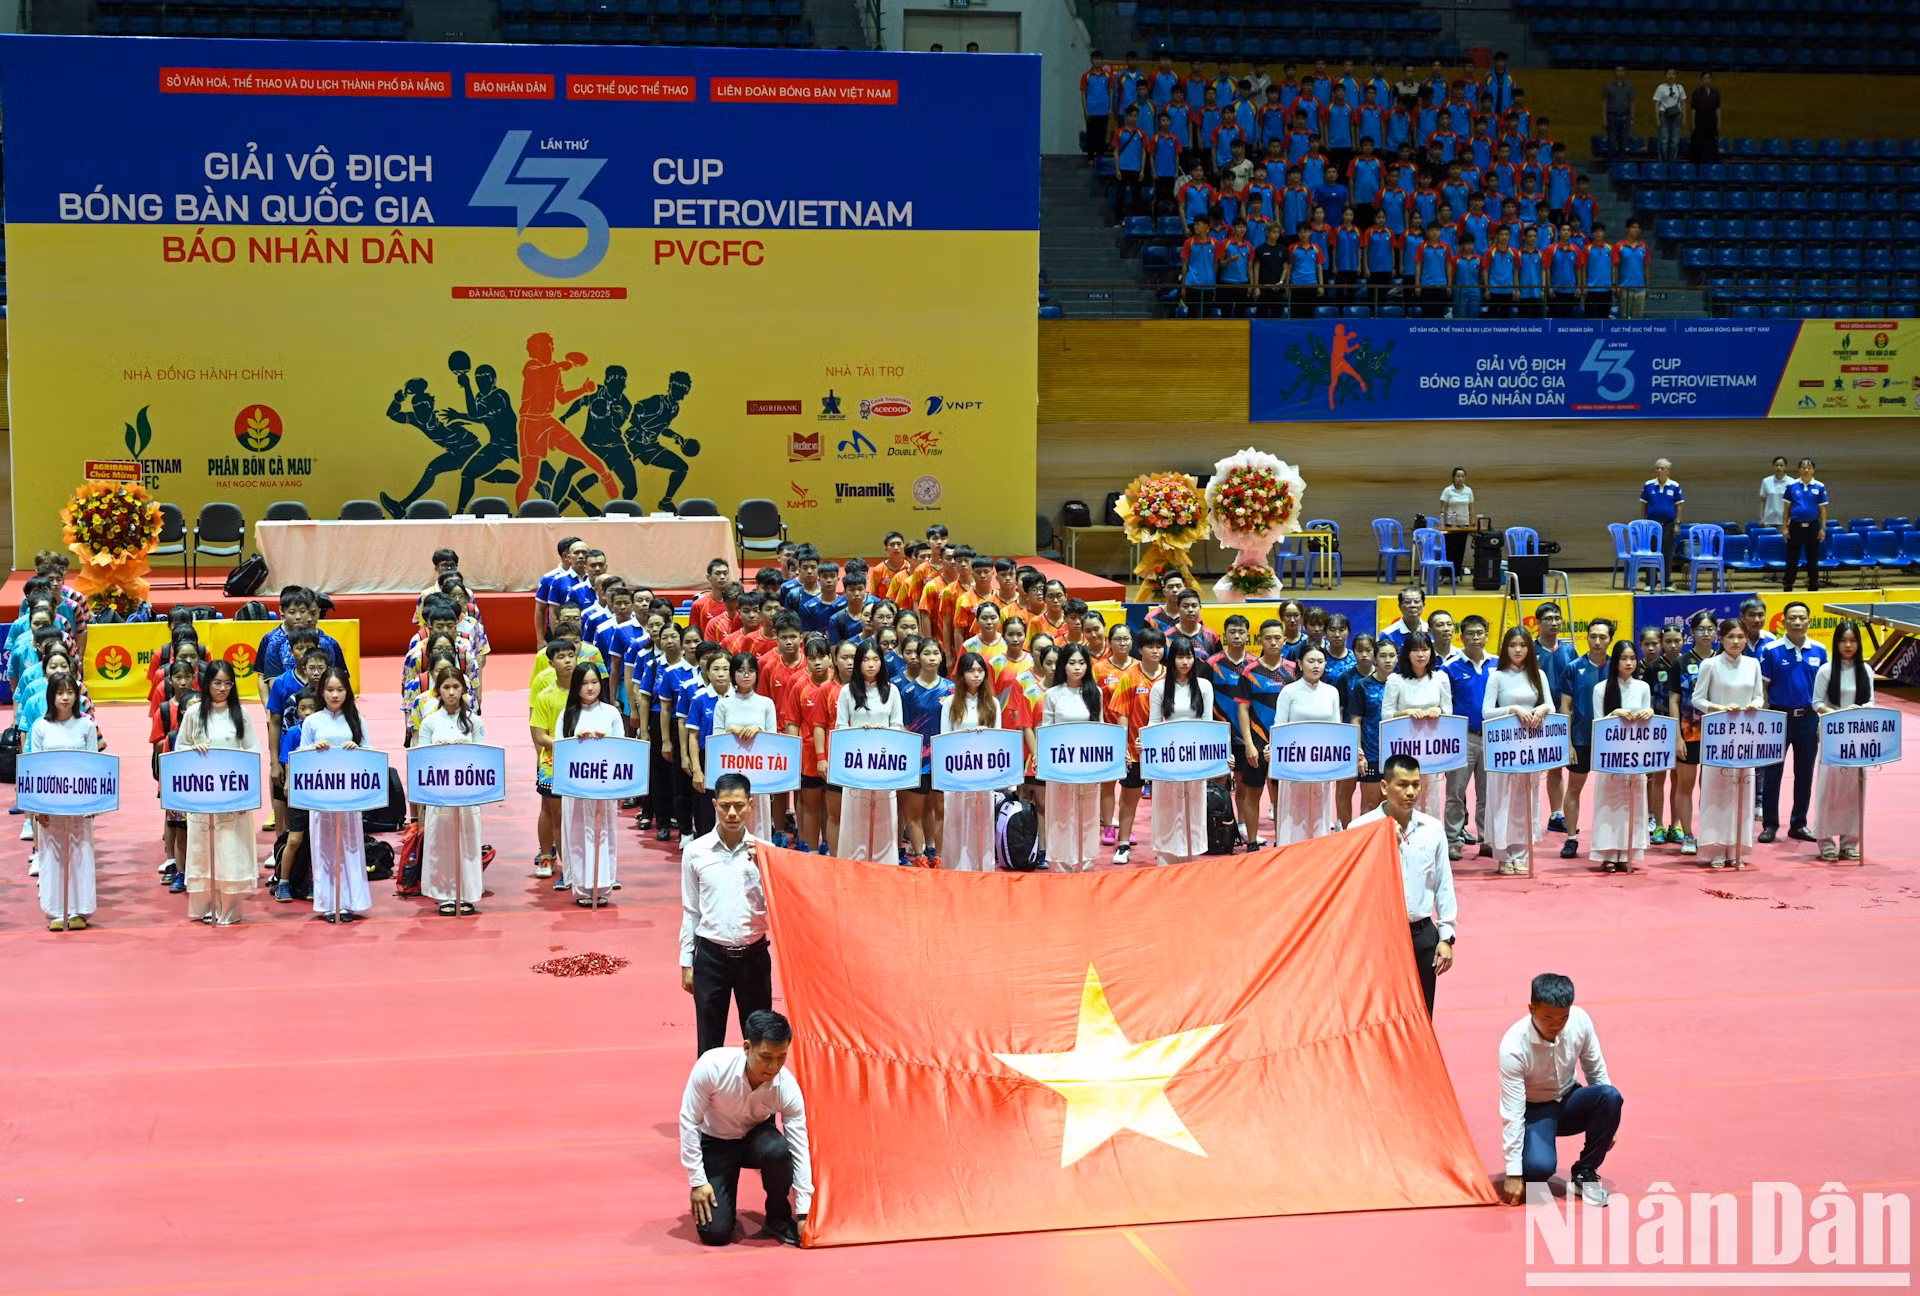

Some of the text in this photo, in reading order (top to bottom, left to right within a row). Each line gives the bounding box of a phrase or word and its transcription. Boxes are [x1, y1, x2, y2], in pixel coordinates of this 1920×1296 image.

[167, 74, 444, 91] SỞ VĂN HOÁ, THỂ THAO VÀ DU LỊCH THÀNH PHỐ ĐÀ NẴNG
[474, 80, 546, 92] BÁO NHÂN DÂN
[574, 80, 688, 95] CỤC THỂ DỤC THỂ THAO
[718, 84, 890, 99] LIÊN ĐOÀN BÓNG BÀN VIỆT NAM
[541, 137, 589, 150] LẦN THỨ
[205, 142, 432, 186] GIẢI VÔ ĐỊCH
[653, 158, 723, 185] CUP
[59, 182, 434, 223] BÓNG BÀN QUỐC GIA
[654, 199, 912, 226] PETROVIETNAM
[163, 228, 433, 264] BÁO NHÂN DÂN
[655, 240, 764, 266] PVCFC
[469, 289, 480, 297] ĐÀ
[482, 288, 507, 298] NẴNG,
[509, 289, 521, 297] TỪ
[522, 289, 542, 297] NGÀY
[124, 365, 282, 380] NHÀ ĐỒNG HÀNH CHÍNH
[826, 364, 905, 378] NHÀ TÀI TRỢ
[1477, 354, 1565, 373] GIẢI VÔ ĐỊCH
[1652, 359, 1681, 370] CUP
[1420, 371, 1565, 388] BÓNG BÀN QUỐC GIA
[1652, 375, 1756, 387] PETROVIETNAM
[1459, 390, 1564, 405] BÁO NHÂN DÂN
[1652, 392, 1696, 404] PVCFC
[888, 448, 917, 456] DOUBLE
[208, 455, 311, 475] PHÂN BÓN CÀ MAU
[112, 471, 137, 480] Mừng
[216, 480, 230, 490] HẠT
[231, 480, 258, 490] NGỌC
[835, 483, 894, 497] Vinamilk
[787, 500, 817, 508] KAMITO
[1892, 640, 1919, 679] SPORT
[1487, 729, 1499, 743] CLB
[1501, 729, 1512, 744] ĐẠI
[1514, 727, 1527, 744] HỌC
[1545, 723, 1567, 737] DƯƠNG
[1606, 725, 1667, 743] CÂU LẠC BỘ
[1708, 722, 1782, 735] CLB P. 14, Q. 10
[1827, 719, 1895, 734] CLB TRÀNG AN
[1051, 744, 1113, 763] TÂY NINH
[1142, 741, 1227, 763] TP. HỒ CHÍ MINH
[1277, 741, 1350, 762] TIỀN GIANG
[1425, 738, 1460, 756] LONG
[1495, 746, 1562, 767] PPP CÀ MAU
[1706, 741, 1782, 760] TP. HỒ CHÍ MINH
[1840, 739, 1881, 761] HÀ NỘI
[721, 753, 787, 772] TRỌNG TÀI
[845, 748, 907, 771] ĐÀ NẴNG
[946, 749, 1010, 773] QUÂN ĐỘI
[1600, 752, 1670, 768] TIMES CITY
[294, 770, 381, 790] KHÁNH HÒA
[419, 764, 495, 786] LÂM ĐỒNG
[570, 760, 633, 783] NGHỆ AN
[18, 771, 115, 794] HẢI DƯƠNG-LONG HẢI
[173, 771, 248, 792] HƯNG YÊN
